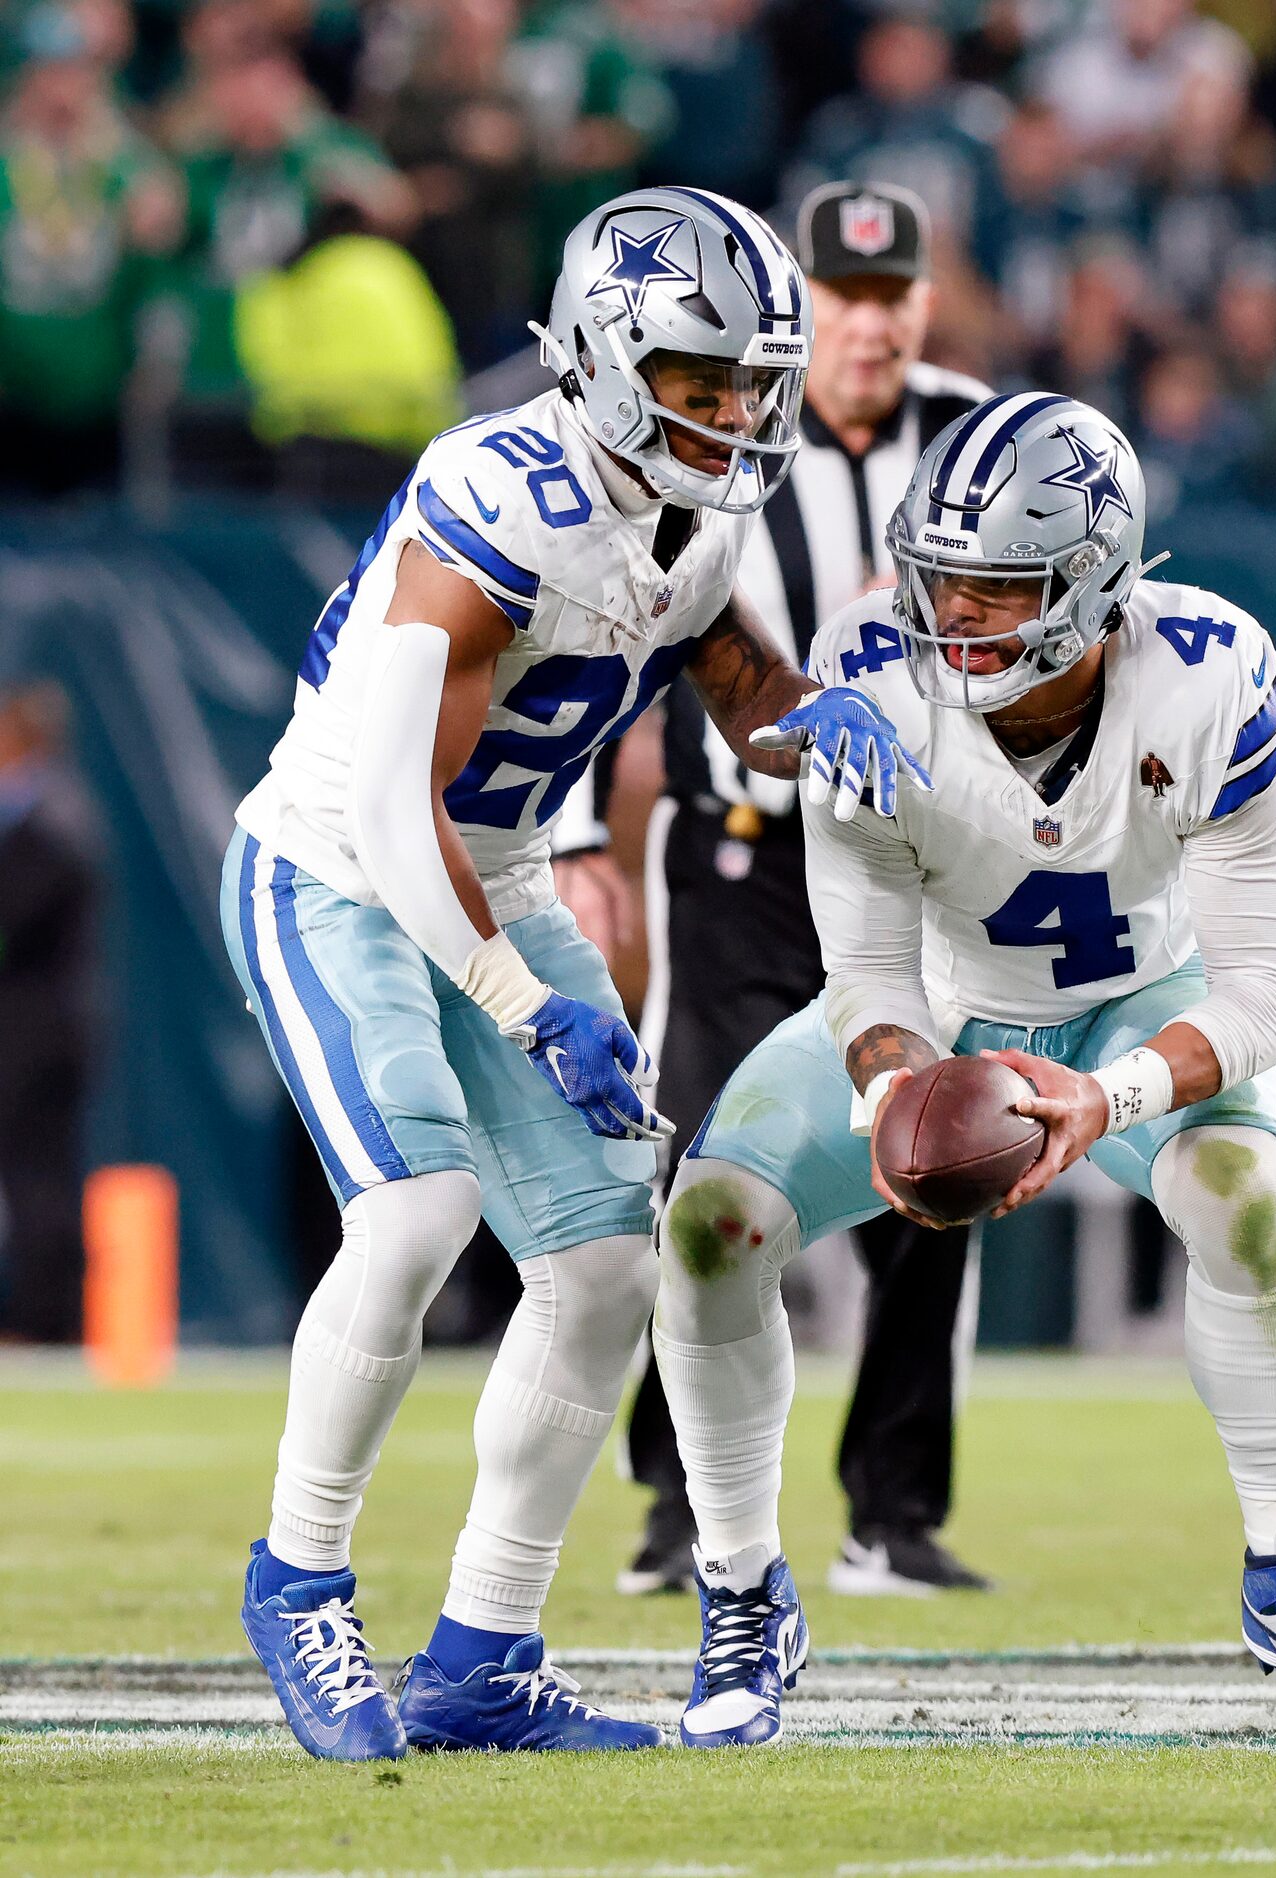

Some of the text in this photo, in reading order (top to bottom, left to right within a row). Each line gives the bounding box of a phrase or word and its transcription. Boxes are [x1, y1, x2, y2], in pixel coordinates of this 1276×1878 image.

[762, 342, 803, 354] COWBOYS
[477, 426, 593, 529] 20
[924, 532, 968, 550] COWBOYS
[1155, 615, 1236, 667] 4
[839, 620, 912, 683] 4
[1037, 830, 1058, 843] NFL
[979, 869, 1136, 990] 4
[706, 1560, 719, 1568] NIKE
[716, 1566, 727, 1574] AIR
